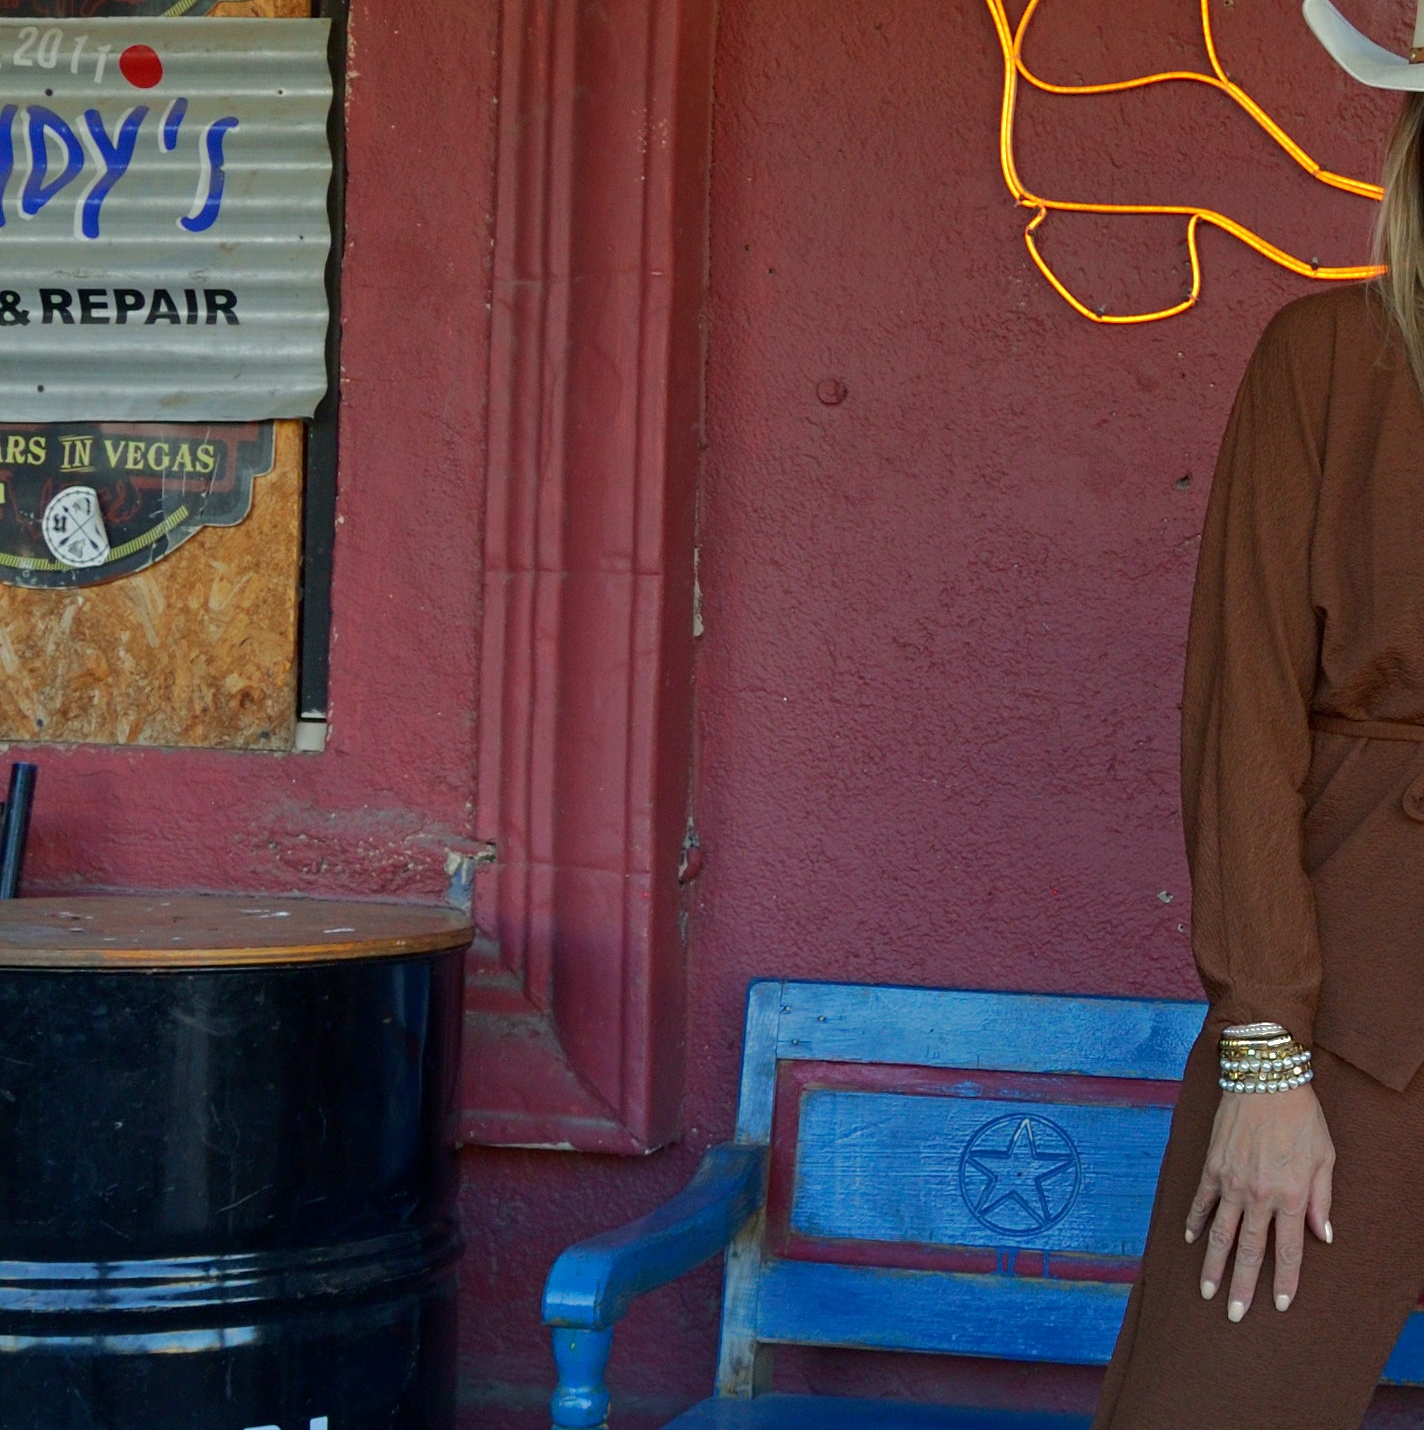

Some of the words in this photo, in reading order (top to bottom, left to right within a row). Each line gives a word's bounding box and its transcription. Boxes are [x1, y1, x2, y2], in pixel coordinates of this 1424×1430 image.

[13, 25, 113, 84] 2011
[0, 289, 31, 327] &
[38, 288, 241, 326] REPAIR
[0, 435, 47, 466] RS
[60, 438, 94, 470] IN
[104, 439, 216, 474] VEGAS
